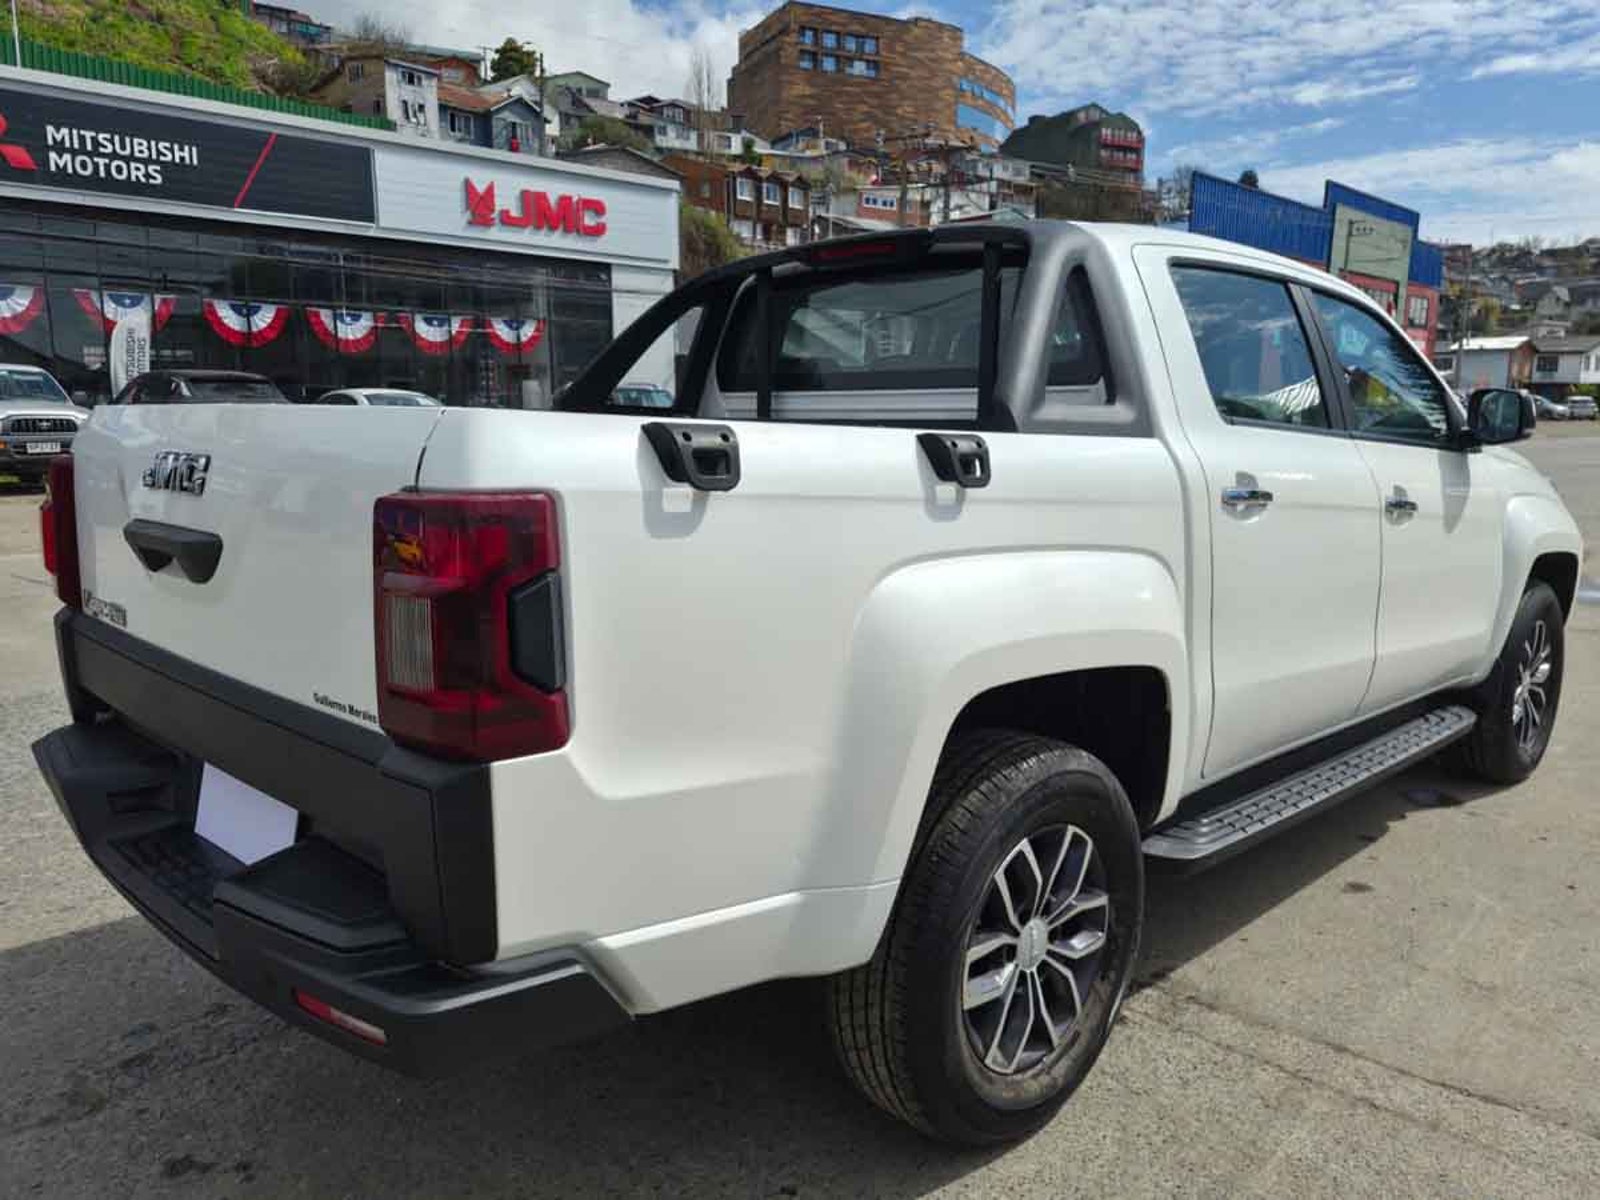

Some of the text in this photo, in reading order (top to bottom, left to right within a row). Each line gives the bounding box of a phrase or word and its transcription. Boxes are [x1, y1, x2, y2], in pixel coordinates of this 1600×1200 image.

[45, 124, 199, 166] MITSUBISHI
[48, 150, 164, 186] MOTORS
[500, 189, 608, 236] JMC
[142, 451, 212, 496] JMC
